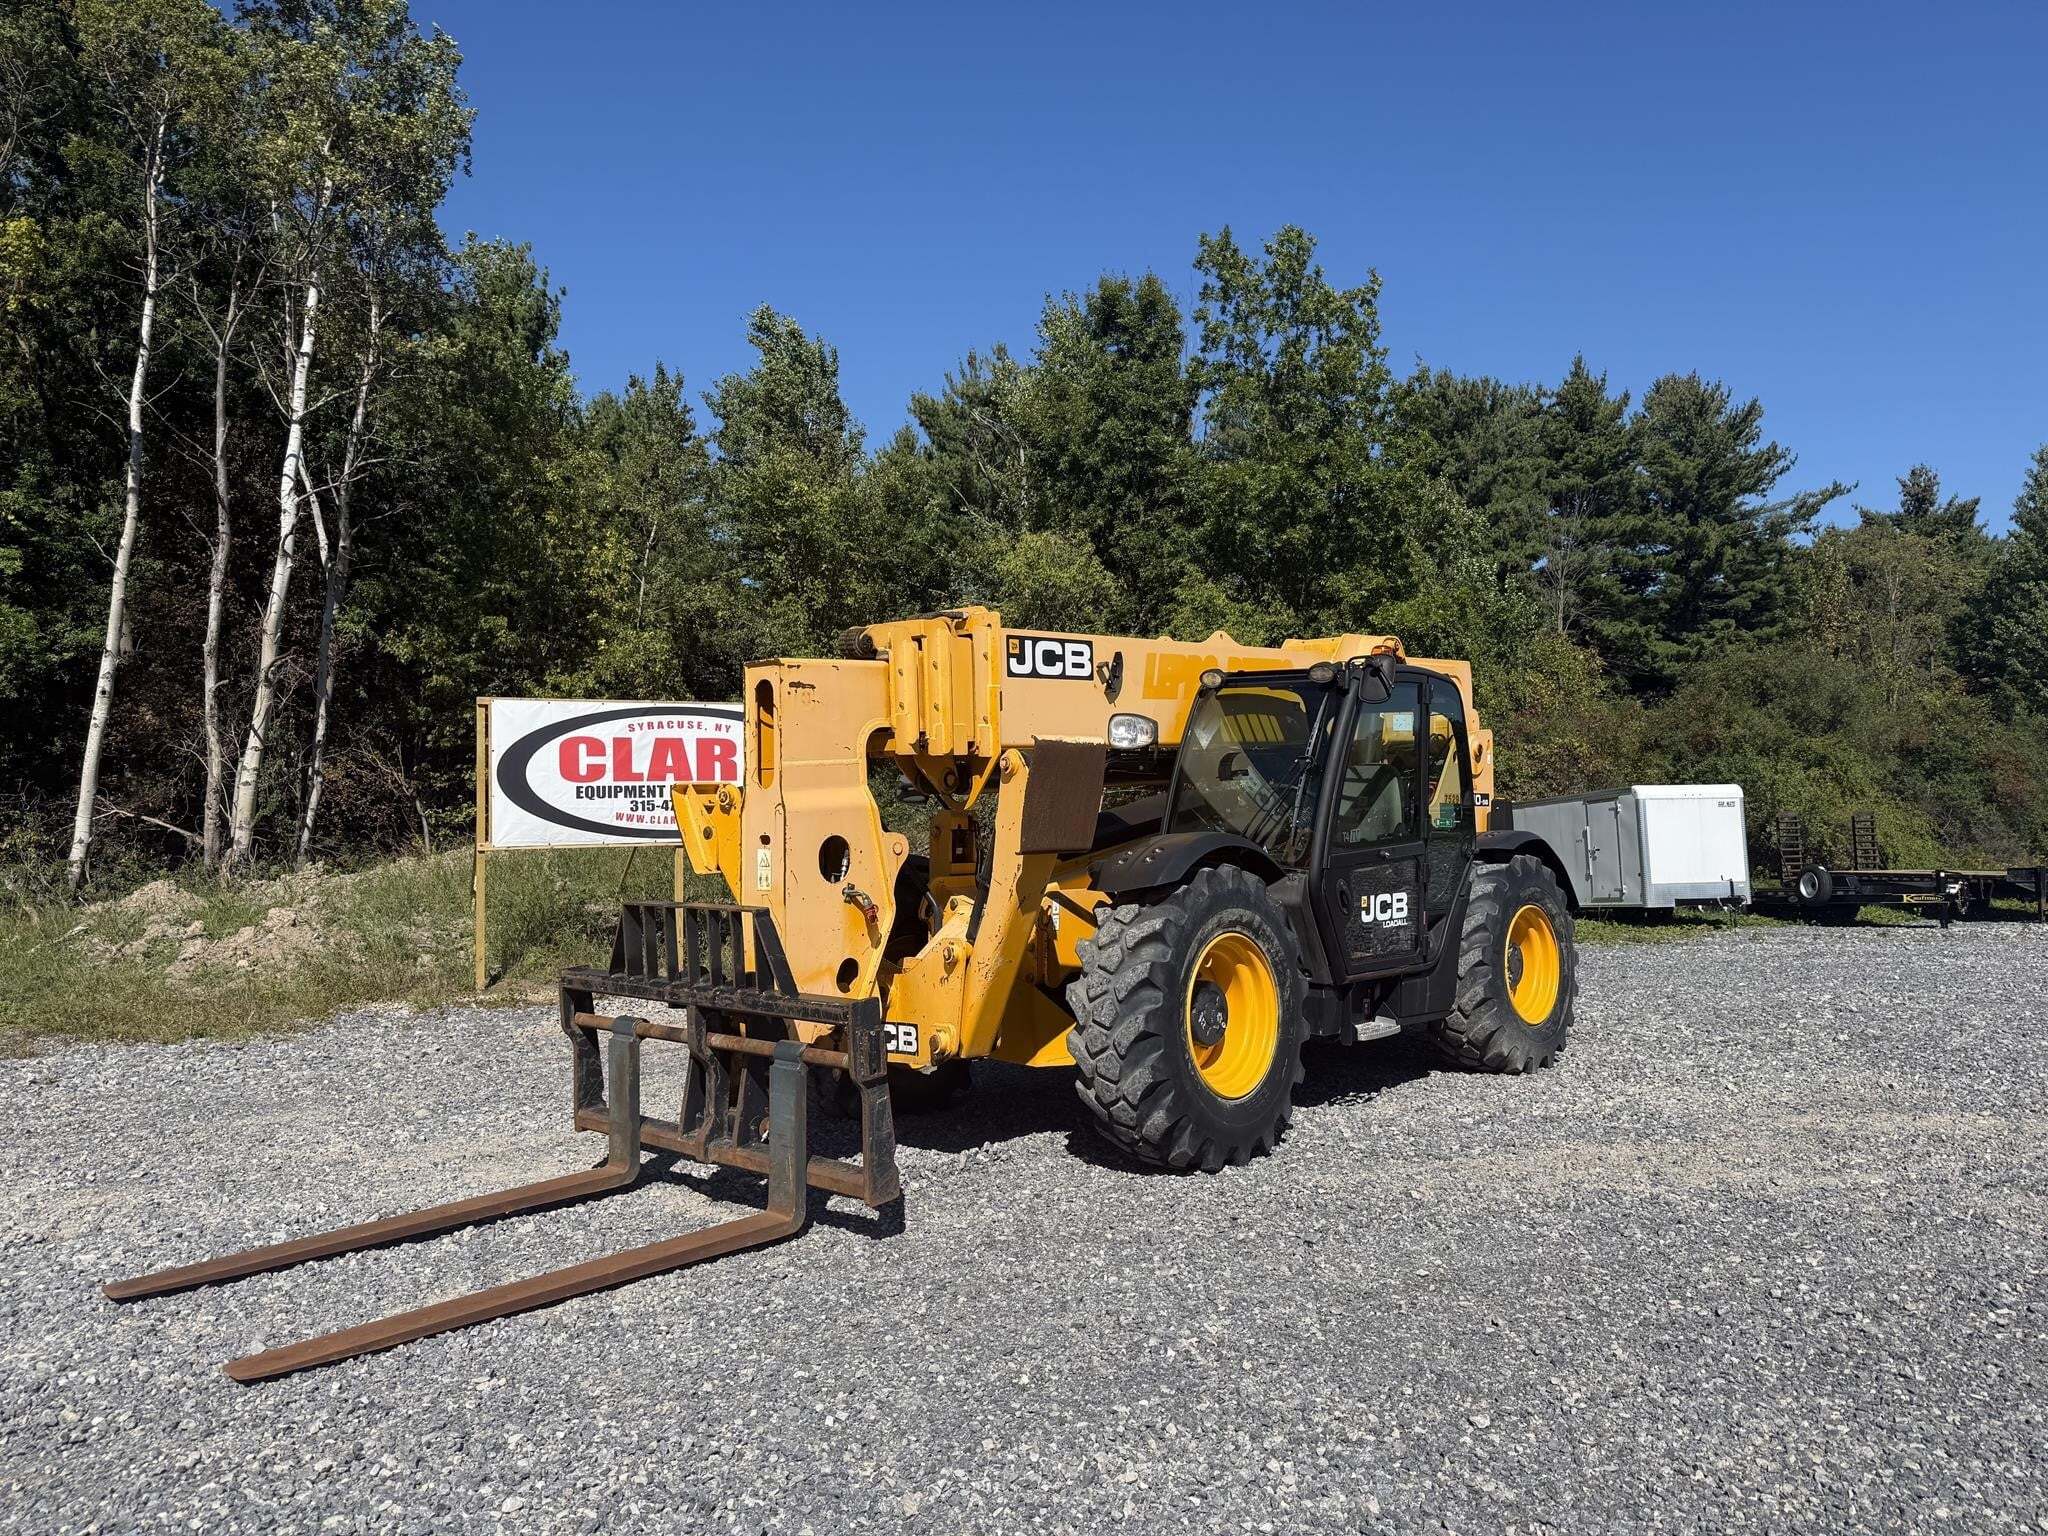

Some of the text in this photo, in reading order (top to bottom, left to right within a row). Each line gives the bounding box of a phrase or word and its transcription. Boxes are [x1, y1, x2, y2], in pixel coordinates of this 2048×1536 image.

[1009, 639, 1092, 677] JCB
[715, 723, 732, 733] NY
[559, 736, 738, 783] CLAR
[576, 785, 666, 800] EQUIPMENT
[1361, 892, 1408, 923] JCB
[1382, 919, 1408, 928] LOADALL
